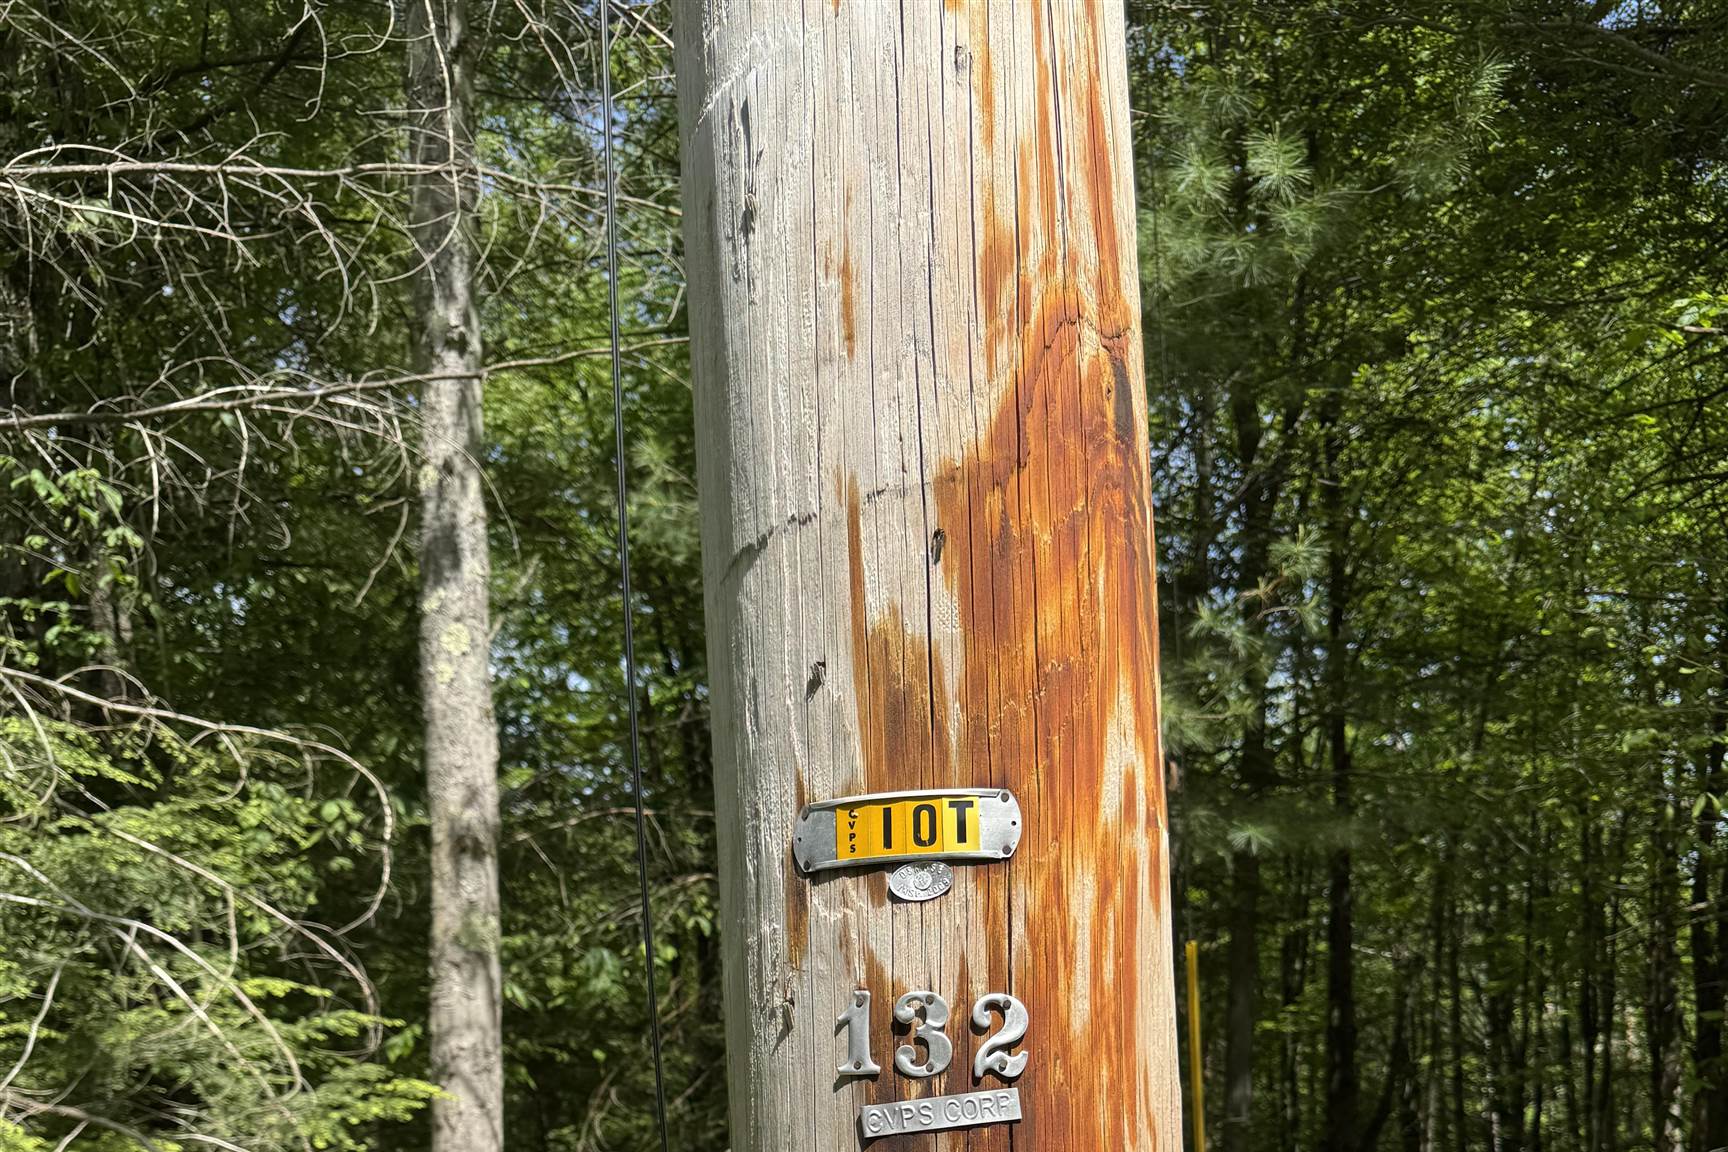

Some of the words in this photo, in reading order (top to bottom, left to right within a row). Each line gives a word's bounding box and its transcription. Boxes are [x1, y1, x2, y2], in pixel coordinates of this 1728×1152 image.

[837, 989, 1029, 1077] 132
[867, 1102, 934, 1133] CVPS
[944, 1092, 1011, 1122] CORP
